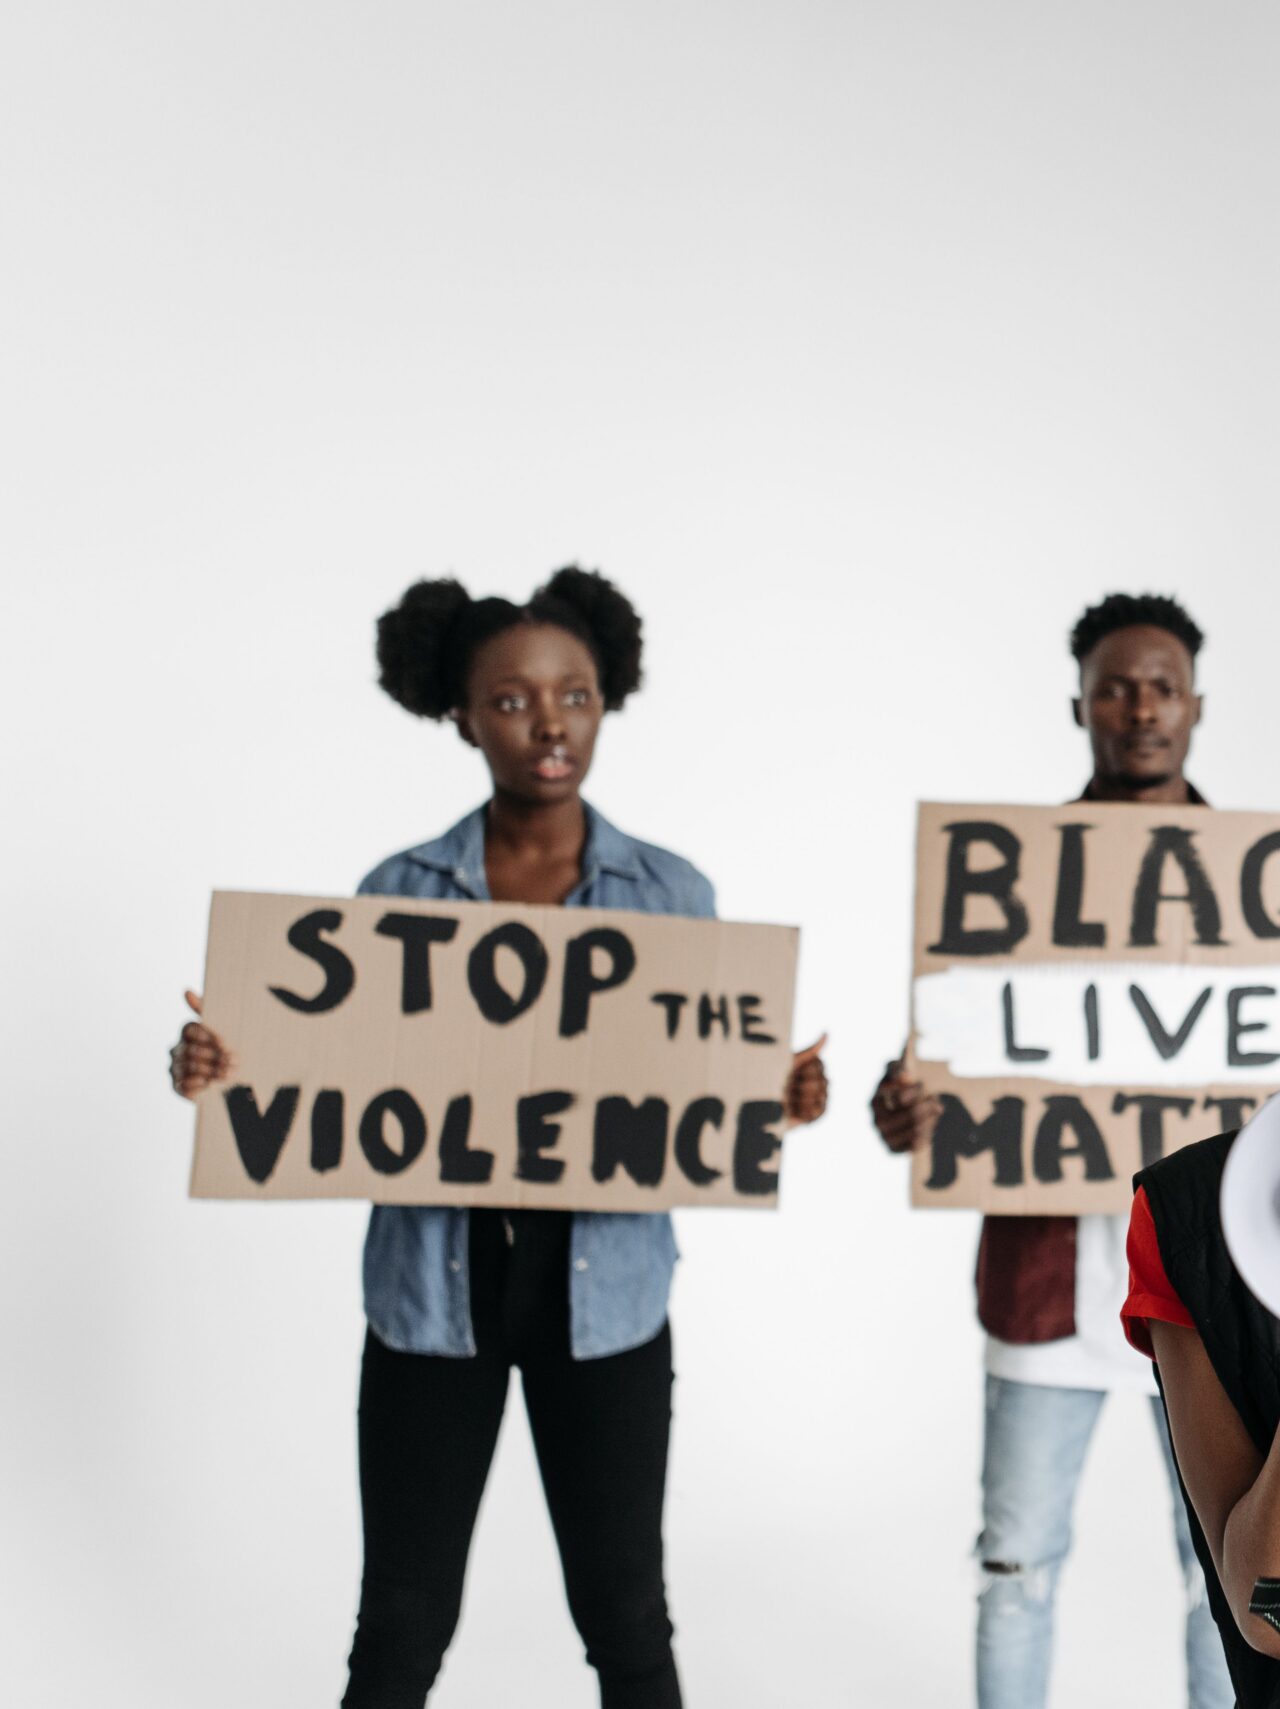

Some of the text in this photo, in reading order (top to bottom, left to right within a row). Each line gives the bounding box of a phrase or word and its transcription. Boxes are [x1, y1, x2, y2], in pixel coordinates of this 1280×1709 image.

[266, 908, 779, 1045] STOP THE
[222, 1083, 785, 1196] VIOLENCE
[923, 1091, 1276, 1190] MATT
